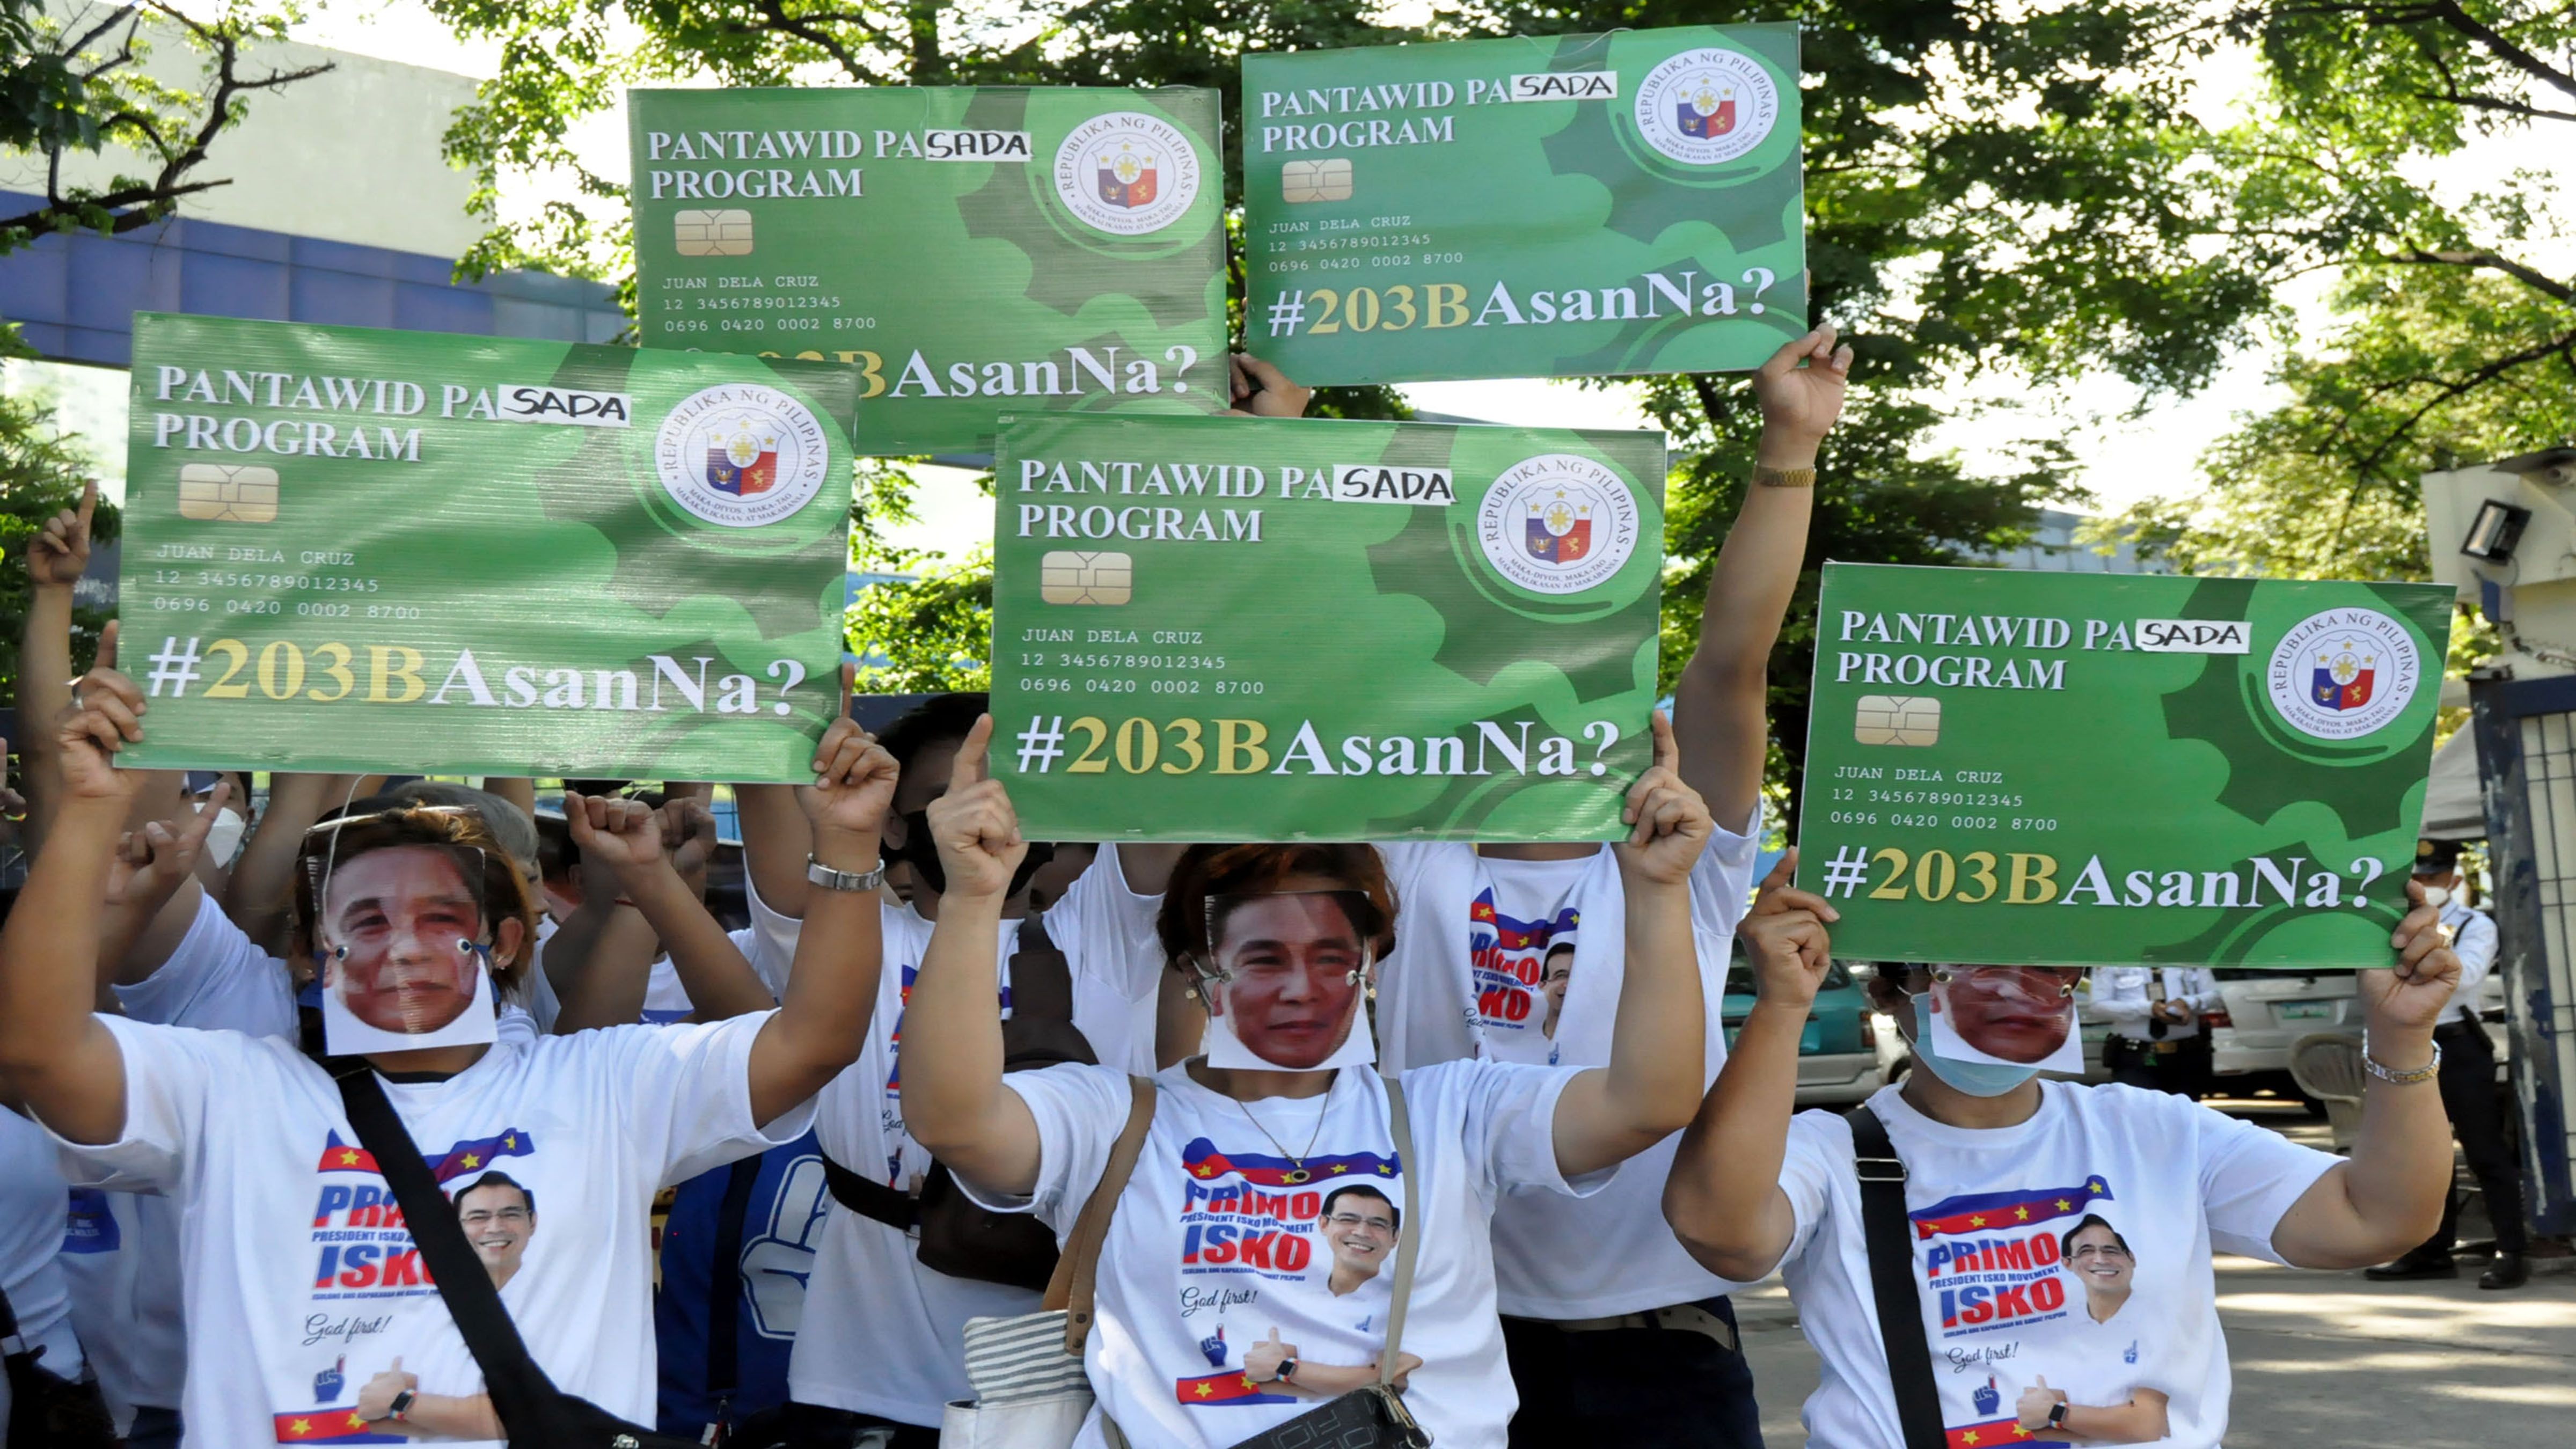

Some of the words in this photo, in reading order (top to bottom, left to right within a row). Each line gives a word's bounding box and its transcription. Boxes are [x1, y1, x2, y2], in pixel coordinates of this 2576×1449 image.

[1262, 79, 1454, 118] PANTAWID
[1641, 57, 1693, 126] REPUBLIKA
[1701, 53, 1723, 63] NG
[1730, 57, 1772, 119] PILIPINAS
[648, 130, 861, 161] PANTAWID
[1262, 116, 1455, 152] PROGRAM
[1060, 120, 1113, 191] REPUBLIKA
[1121, 117, 1145, 129] NG
[1151, 123, 1193, 191] PILIPINAS
[649, 169, 863, 200] PROGRAM
[1269, 222, 1309, 233] JUAN
[1320, 219, 1360, 230] DELA
[1371, 216, 1410, 227] CRUZ
[1269, 241, 1286, 251] 12
[1298, 233, 1431, 251] 3456789012345
[1269, 261, 1309, 272] 0696
[1320, 258, 1360, 269] 0420
[1372, 255, 1411, 267] 0002
[1424, 252, 1462, 264] 8700
[663, 278, 707, 289] JUAN
[718, 276, 763, 288] DELA
[774, 276, 819, 287] CRUZ
[664, 299, 683, 310] 12
[697, 296, 840, 309] 3456789012345
[1268, 267, 1775, 336] #203BAsanNa?
[665, 321, 708, 331] 0696
[721, 319, 763, 330] 0420
[778, 318, 820, 330] 0002
[833, 318, 876, 329] 8700
[759, 346, 1197, 399] BAsanNa?
[156, 365, 425, 415] PANTAWID
[154, 414, 421, 462] PROGRAM
[662, 392, 731, 471] REPUBLIKA
[741, 389, 769, 404] NG
[775, 399, 820, 479] PILIPINAS
[1019, 459, 1264, 500] PANTAWID
[1485, 462, 1548, 541] REPUBLIKA
[1556, 460, 1583, 473] NG
[1589, 469, 1631, 544] PILIPINAS
[1018, 505, 1263, 543] PROGRAM
[157, 545, 213, 560] JUAN
[229, 547, 286, 563] DELA
[300, 551, 354, 566] CRUZ
[155, 571, 181, 584] 12
[198, 572, 379, 593] 3456789012345
[154, 597, 210, 612] 0696
[226, 599, 282, 614] 0420
[297, 602, 351, 617] 0002
[368, 604, 420, 620] 8700
[1022, 628, 1074, 643] JUAN
[1088, 630, 1138, 643] DELA
[1153, 632, 1203, 645] CRUZ
[1840, 611, 2070, 649] PANTAWID
[1021, 654, 1044, 667] 12
[1060, 654, 1226, 669] 3456789012345
[2274, 616, 2338, 690] REPUBLIKA
[2346, 613, 2372, 626] NG
[2376, 621, 2413, 693] PILIPINAS
[148, 636, 806, 715] #203BAsanNa?
[1021, 679, 1071, 692] 0696
[1087, 680, 1137, 692] 0420
[1151, 680, 1201, 693] 0002
[1216, 682, 1264, 694] 8700
[1837, 652, 2067, 691] PROGRAM
[1018, 715, 1619, 777] #203BAsanNa?
[1834, 766, 1883, 779] JUAN
[1896, 769, 1943, 781] DELA
[1956, 771, 2003, 784] CRUZ
[1832, 788, 1855, 801] 12
[1868, 789, 2023, 807] 3456789012345
[1831, 813, 1877, 825] 0696
[1891, 815, 1938, 827] 0420
[1951, 817, 1998, 829] 0002
[2011, 818, 2058, 831] 8700
[1824, 845, 2383, 909] #203BAsanNa?
[1475, 981, 1531, 1021] KO
[1182, 1179, 1321, 1220] PRIMO
[312, 1231, 376, 1241] PRESIDENT
[1180, 1212, 1234, 1223] PRESIDENT
[1237, 1217, 1260, 1227] ISKO
[1183, 1225, 1311, 1272] ISKO
[1928, 1232, 2060, 1278] PRIMO
[1929, 1275, 1982, 1290] PRESIDENT
[1984, 1274, 2006, 1282] ISKO
[2009, 1265, 2059, 1281] MOVEMENT
[1180, 1286, 1218, 1317] God
[1220, 1290, 1257, 1314] first!
[1941, 1277, 2065, 1328] ISKO
[302, 1313, 345, 1345] God
[346, 1315, 392, 1344] first!
[1945, 1347, 1981, 1374] God
[1985, 1342, 2019, 1367] first!
